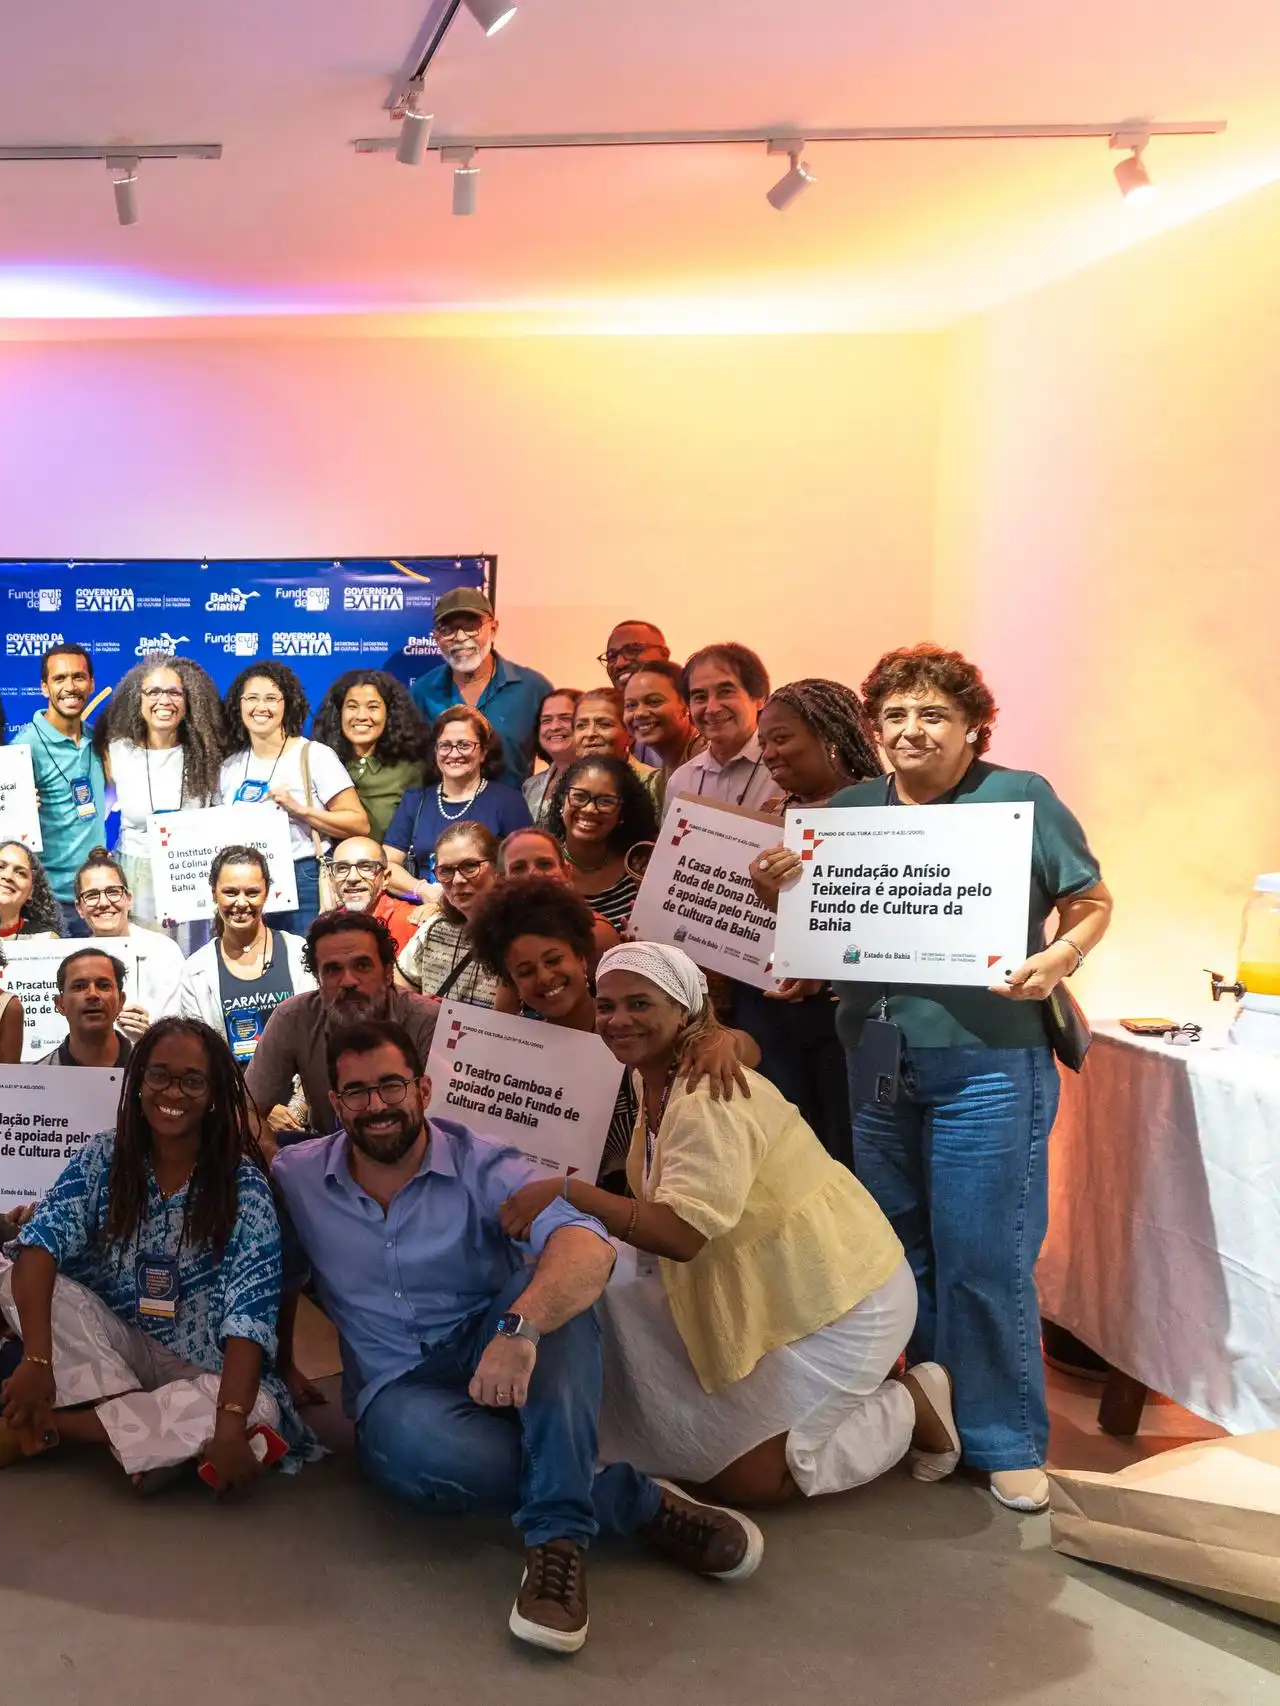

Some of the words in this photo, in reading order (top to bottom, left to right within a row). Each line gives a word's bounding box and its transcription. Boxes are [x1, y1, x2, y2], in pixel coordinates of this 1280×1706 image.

[8, 589, 39, 599] Fundo
[76, 588, 117, 596] GOVERNO
[120, 588, 134, 596] DA
[211, 593, 240, 602] Bahia
[276, 588, 308, 599] Fundo
[344, 587, 386, 596] GOVERNO
[388, 587, 403, 596] DA
[27, 598, 39, 608] de
[76, 596, 134, 611] BAHIA
[205, 602, 244, 612] Criativa
[295, 598, 307, 608] de
[344, 595, 403, 611] BAHIA
[6, 633, 47, 641] GOVERNO
[50, 633, 64, 641] DA
[140, 637, 168, 647] Bahia
[204, 632, 236, 644] Fundo
[272, 632, 314, 640] GOVERNO
[316, 632, 331, 640] DA
[223, 643, 236, 653] de
[272, 640, 331, 656] BAHIA
[168, 851, 175, 859] O
[177, 847, 212, 859] Instituto
[169, 861, 180, 870] da
[182, 858, 208, 869] Colina
[678, 855, 687, 867] A
[688, 858, 711, 875] Casa
[713, 866, 727, 881] do
[170, 872, 197, 882] Fundo
[199, 869, 210, 879] de
[813, 865, 824, 877] A
[827, 864, 899, 881] Fundação
[903, 864, 950, 878] Anísio
[172, 882, 196, 892] Bahia
[673, 870, 699, 888] Roda
[701, 878, 715, 892] de
[715, 883, 744, 902] Dona
[812, 883, 871, 896] Teixeira
[875, 882, 885, 896] é
[888, 883, 952, 900] apoiada
[957, 883, 992, 900] pelo
[668, 884, 676, 896] é
[677, 888, 717, 910] apoiada
[717, 902, 742, 919] pelo
[743, 911, 777, 931] Fundo
[810, 900, 856, 914] Fundo
[860, 900, 879, 914] de
[883, 901, 939, 915] Cultura
[943, 901, 963, 916] da
[662, 900, 676, 913] de
[677, 904, 713, 926] Cultura
[714, 917, 728, 932] da
[729, 922, 761, 943] Bahia
[809, 918, 851, 932] Bahia
[864, 951, 884, 959] Estado
[893, 952, 911, 960] Bahia
[7, 981, 14, 990] A
[44, 993, 50, 1002] é
[40, 1005, 51, 1014] de
[453, 1061, 463, 1073] O
[465, 1064, 501, 1083] Teatro
[504, 1074, 552, 1097] Gamboa
[554, 1087, 563, 1100] é
[449, 1077, 495, 1098] apoiado
[497, 1089, 523, 1108] pelo
[525, 1096, 562, 1117] Fundo
[564, 1107, 580, 1122] de
[446, 1092, 485, 1113] Cultura
[487, 1103, 502, 1117] da
[504, 1107, 539, 1128] Bahia
[33, 1115, 68, 1127] Pierre
[4, 1128, 12, 1140] é
[14, 1130, 62, 1143] apoiada
[1, 1144, 15, 1156] de
[19, 1145, 61, 1158] Cultura
